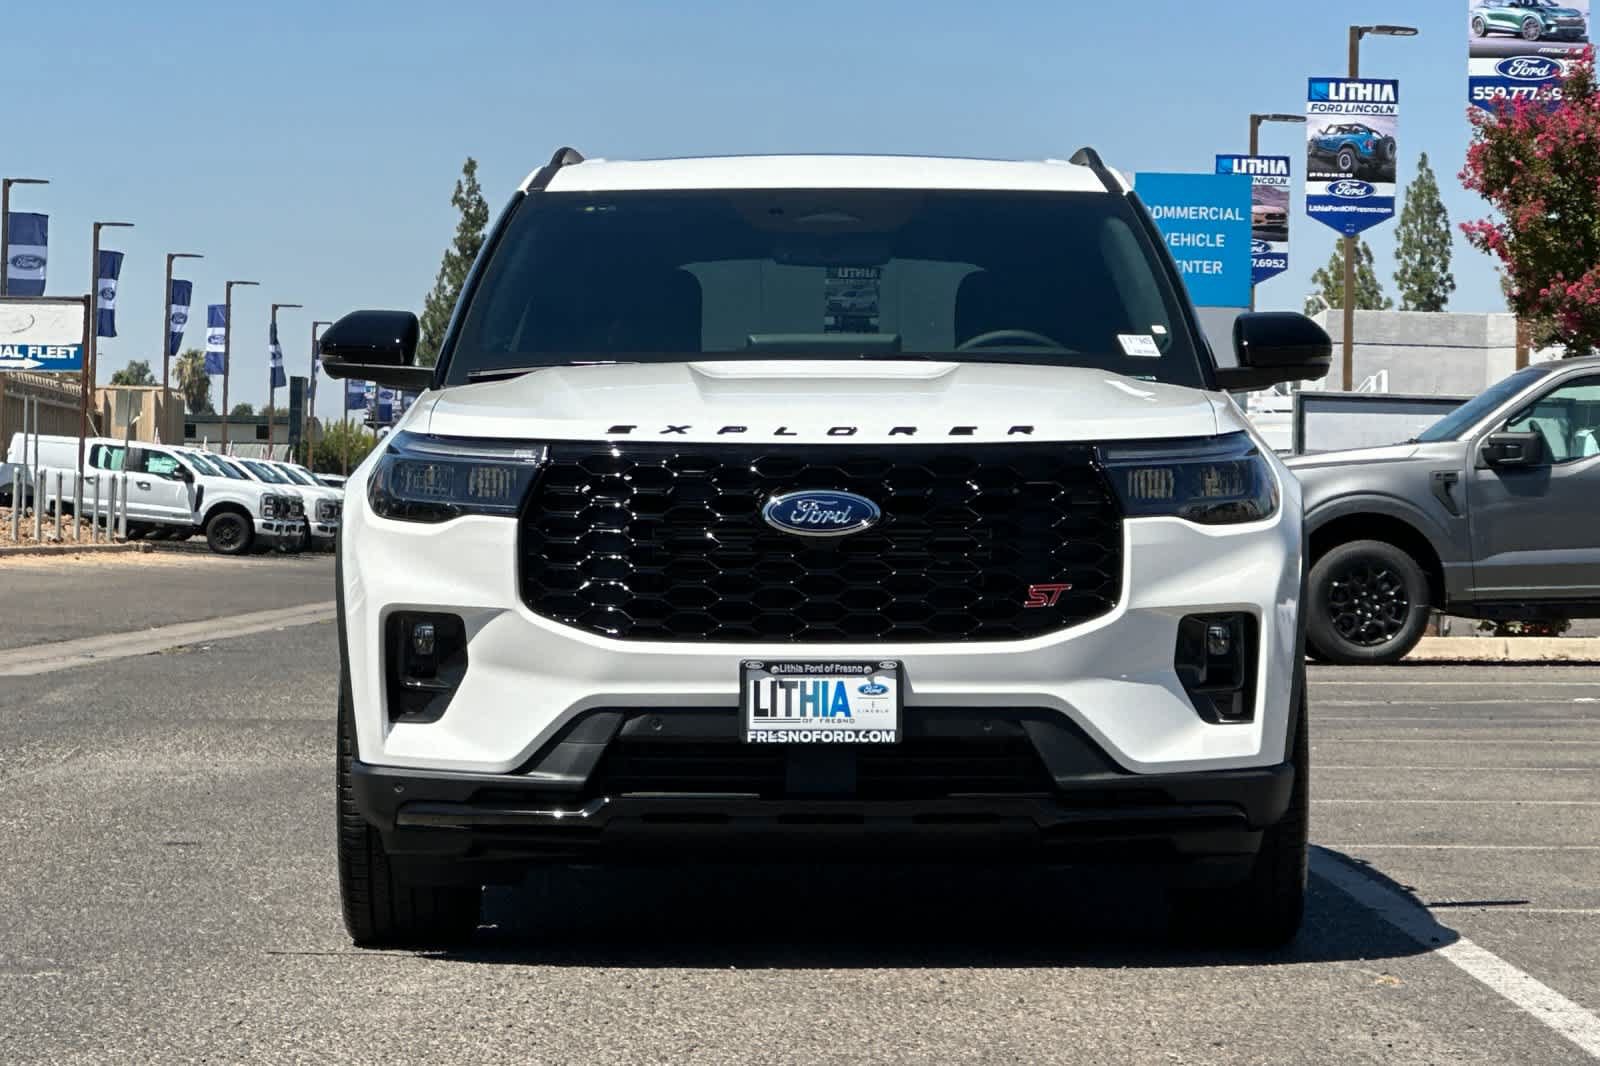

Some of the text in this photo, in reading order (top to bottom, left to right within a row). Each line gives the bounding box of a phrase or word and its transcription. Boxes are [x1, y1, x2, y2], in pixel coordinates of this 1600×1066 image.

[1508, 59, 1550, 76] Ford
[1329, 82, 1396, 102] LITHIA
[1473, 86, 1573, 100] 559.777.9
[1311, 103, 1395, 114] FORD LINCOLN
[1232, 158, 1288, 175] LITHIA
[1252, 177, 1287, 185] NCOLN
[1335, 182, 1367, 196] Ford
[1147, 205, 1245, 221] OMMERCIAL
[1175, 259, 1223, 275] NTER
[27, 346, 78, 359] FLEET
[606, 424, 1036, 437] EXPLORER
[790, 499, 853, 524] Ford
[1023, 583, 1073, 608] ST
[779, 664, 863, 673] Lithia Ford of Fresno
[753, 680, 852, 718] LITHIA
[747, 730, 896, 743] FRESNOFORD.COM
